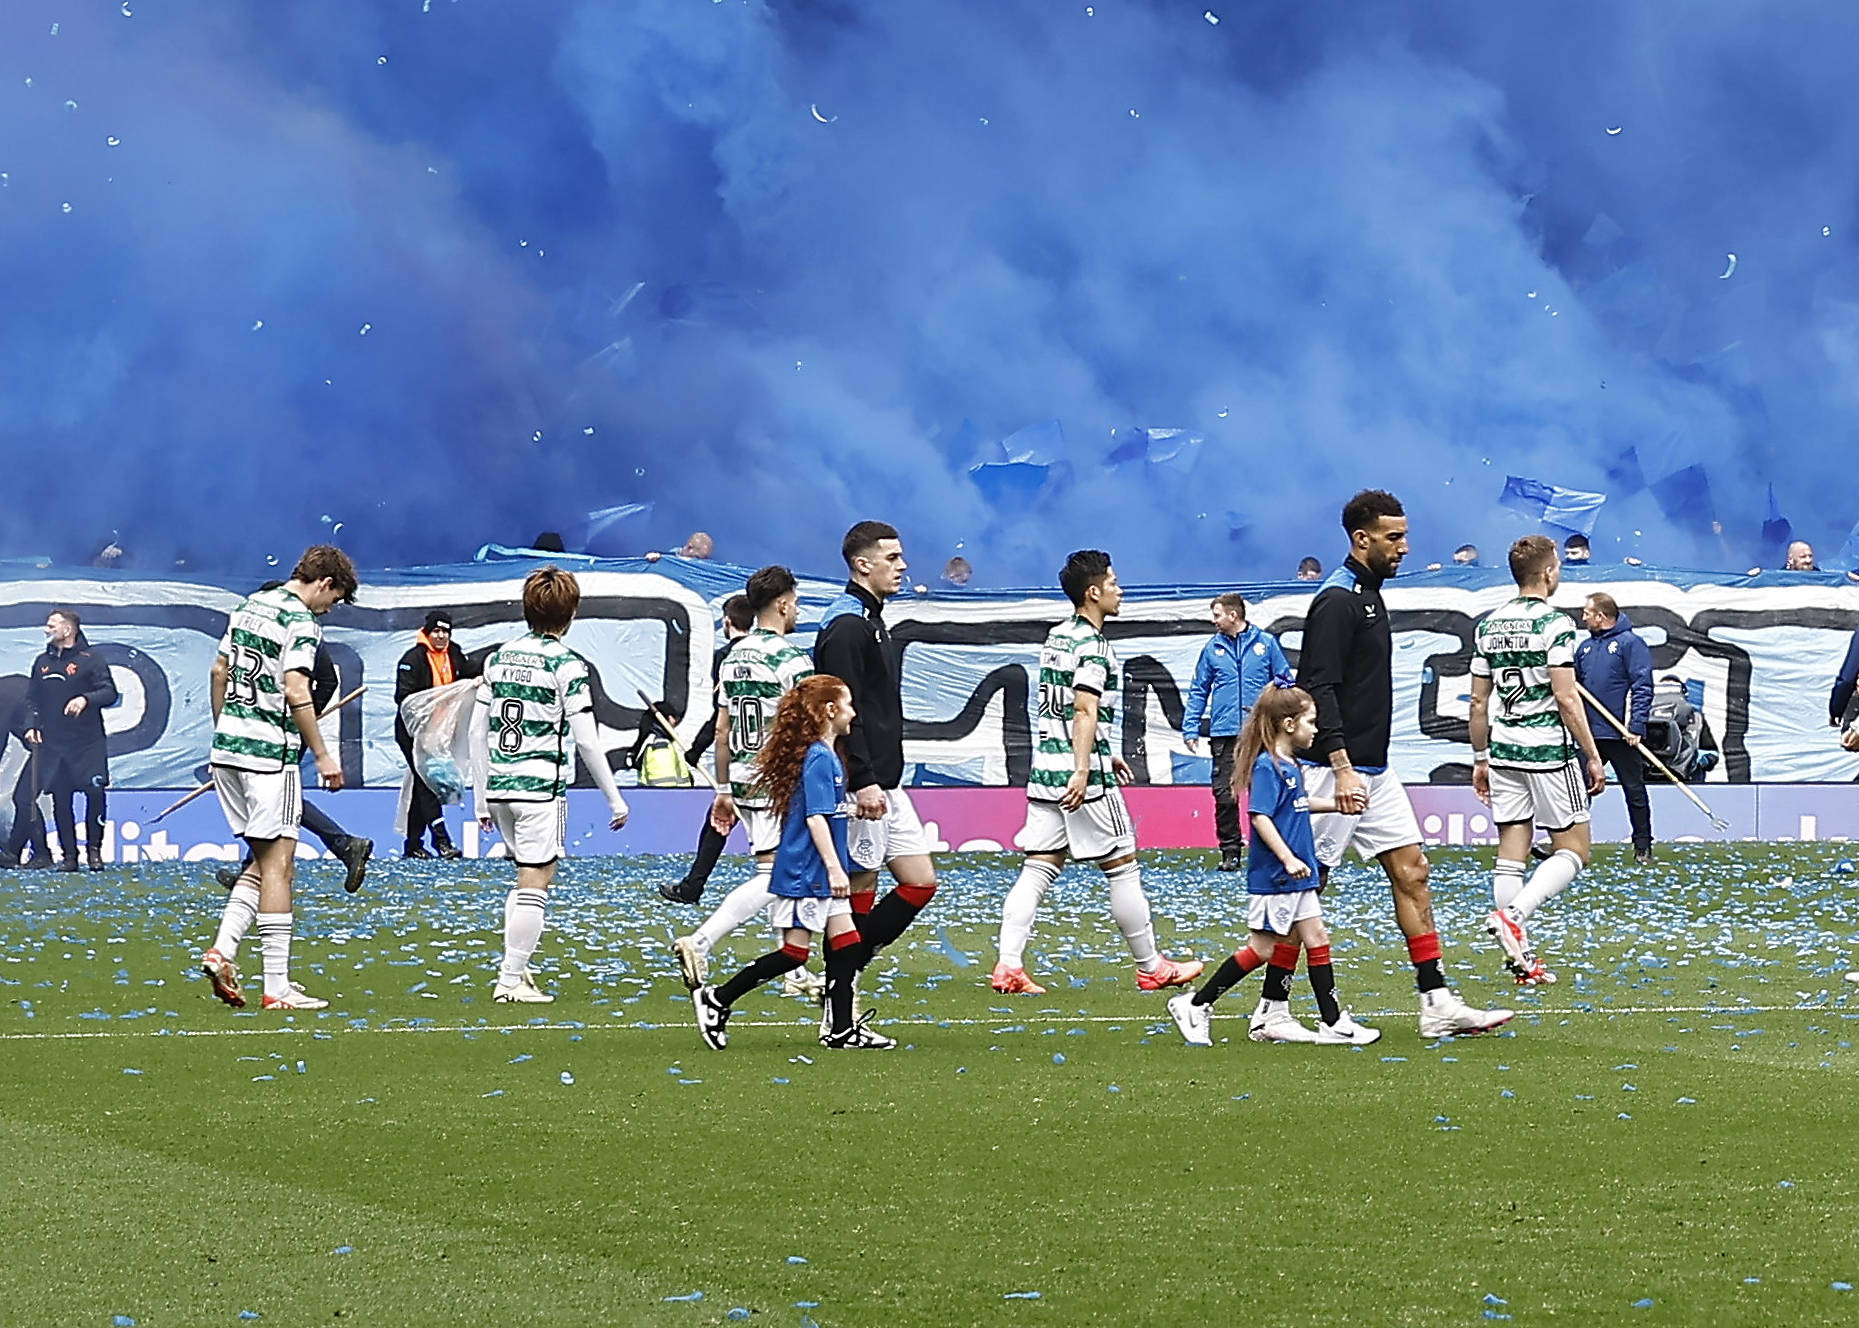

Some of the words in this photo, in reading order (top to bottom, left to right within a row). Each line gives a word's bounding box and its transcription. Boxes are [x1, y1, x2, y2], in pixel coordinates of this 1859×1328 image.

[1487, 635, 1530, 651] JOHNSTON
[501, 668, 532, 683] KYOGO
[500, 699, 524, 753] 8
